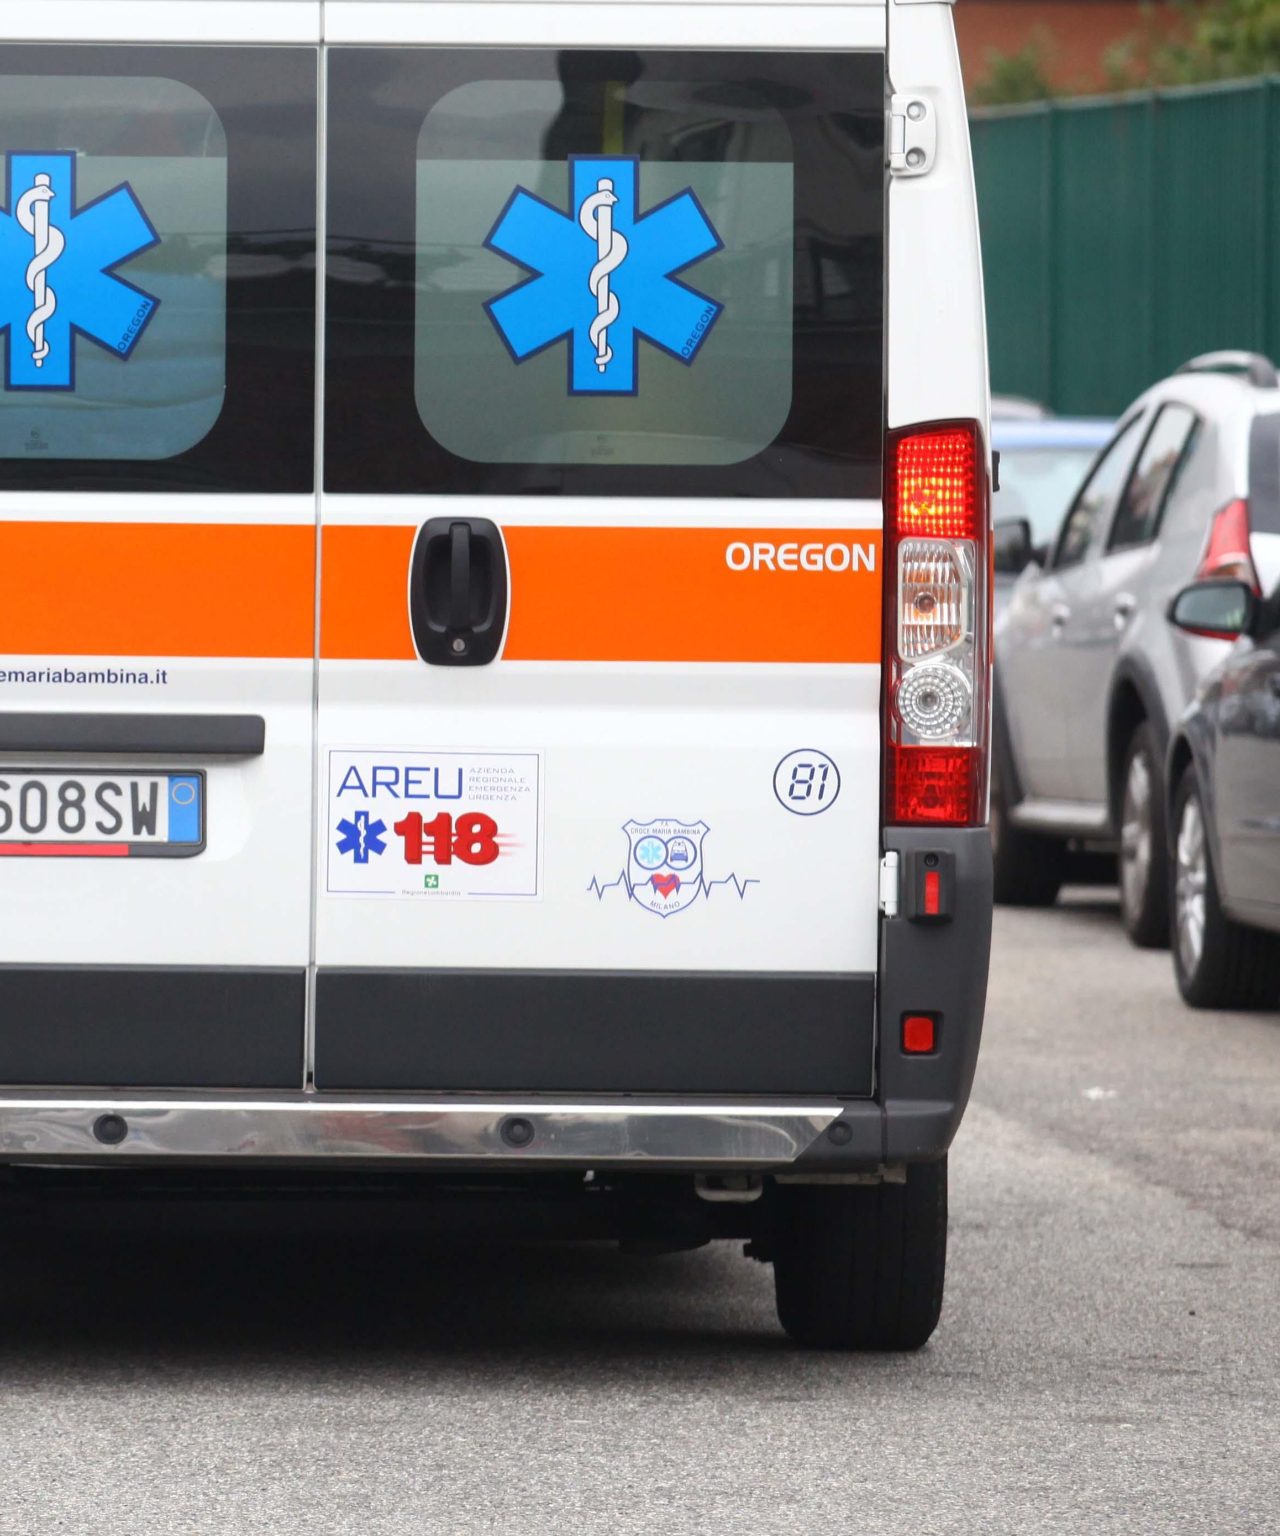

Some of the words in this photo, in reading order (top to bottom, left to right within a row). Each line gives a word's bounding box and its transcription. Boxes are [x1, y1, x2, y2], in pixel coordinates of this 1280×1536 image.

[117, 300, 151, 352] OREGON
[681, 305, 715, 357] OREGON
[725, 541, 876, 572] OREGON
[336, 766, 463, 799] AREU
[788, 763, 829, 801] 81
[393, 811, 500, 866] 118
